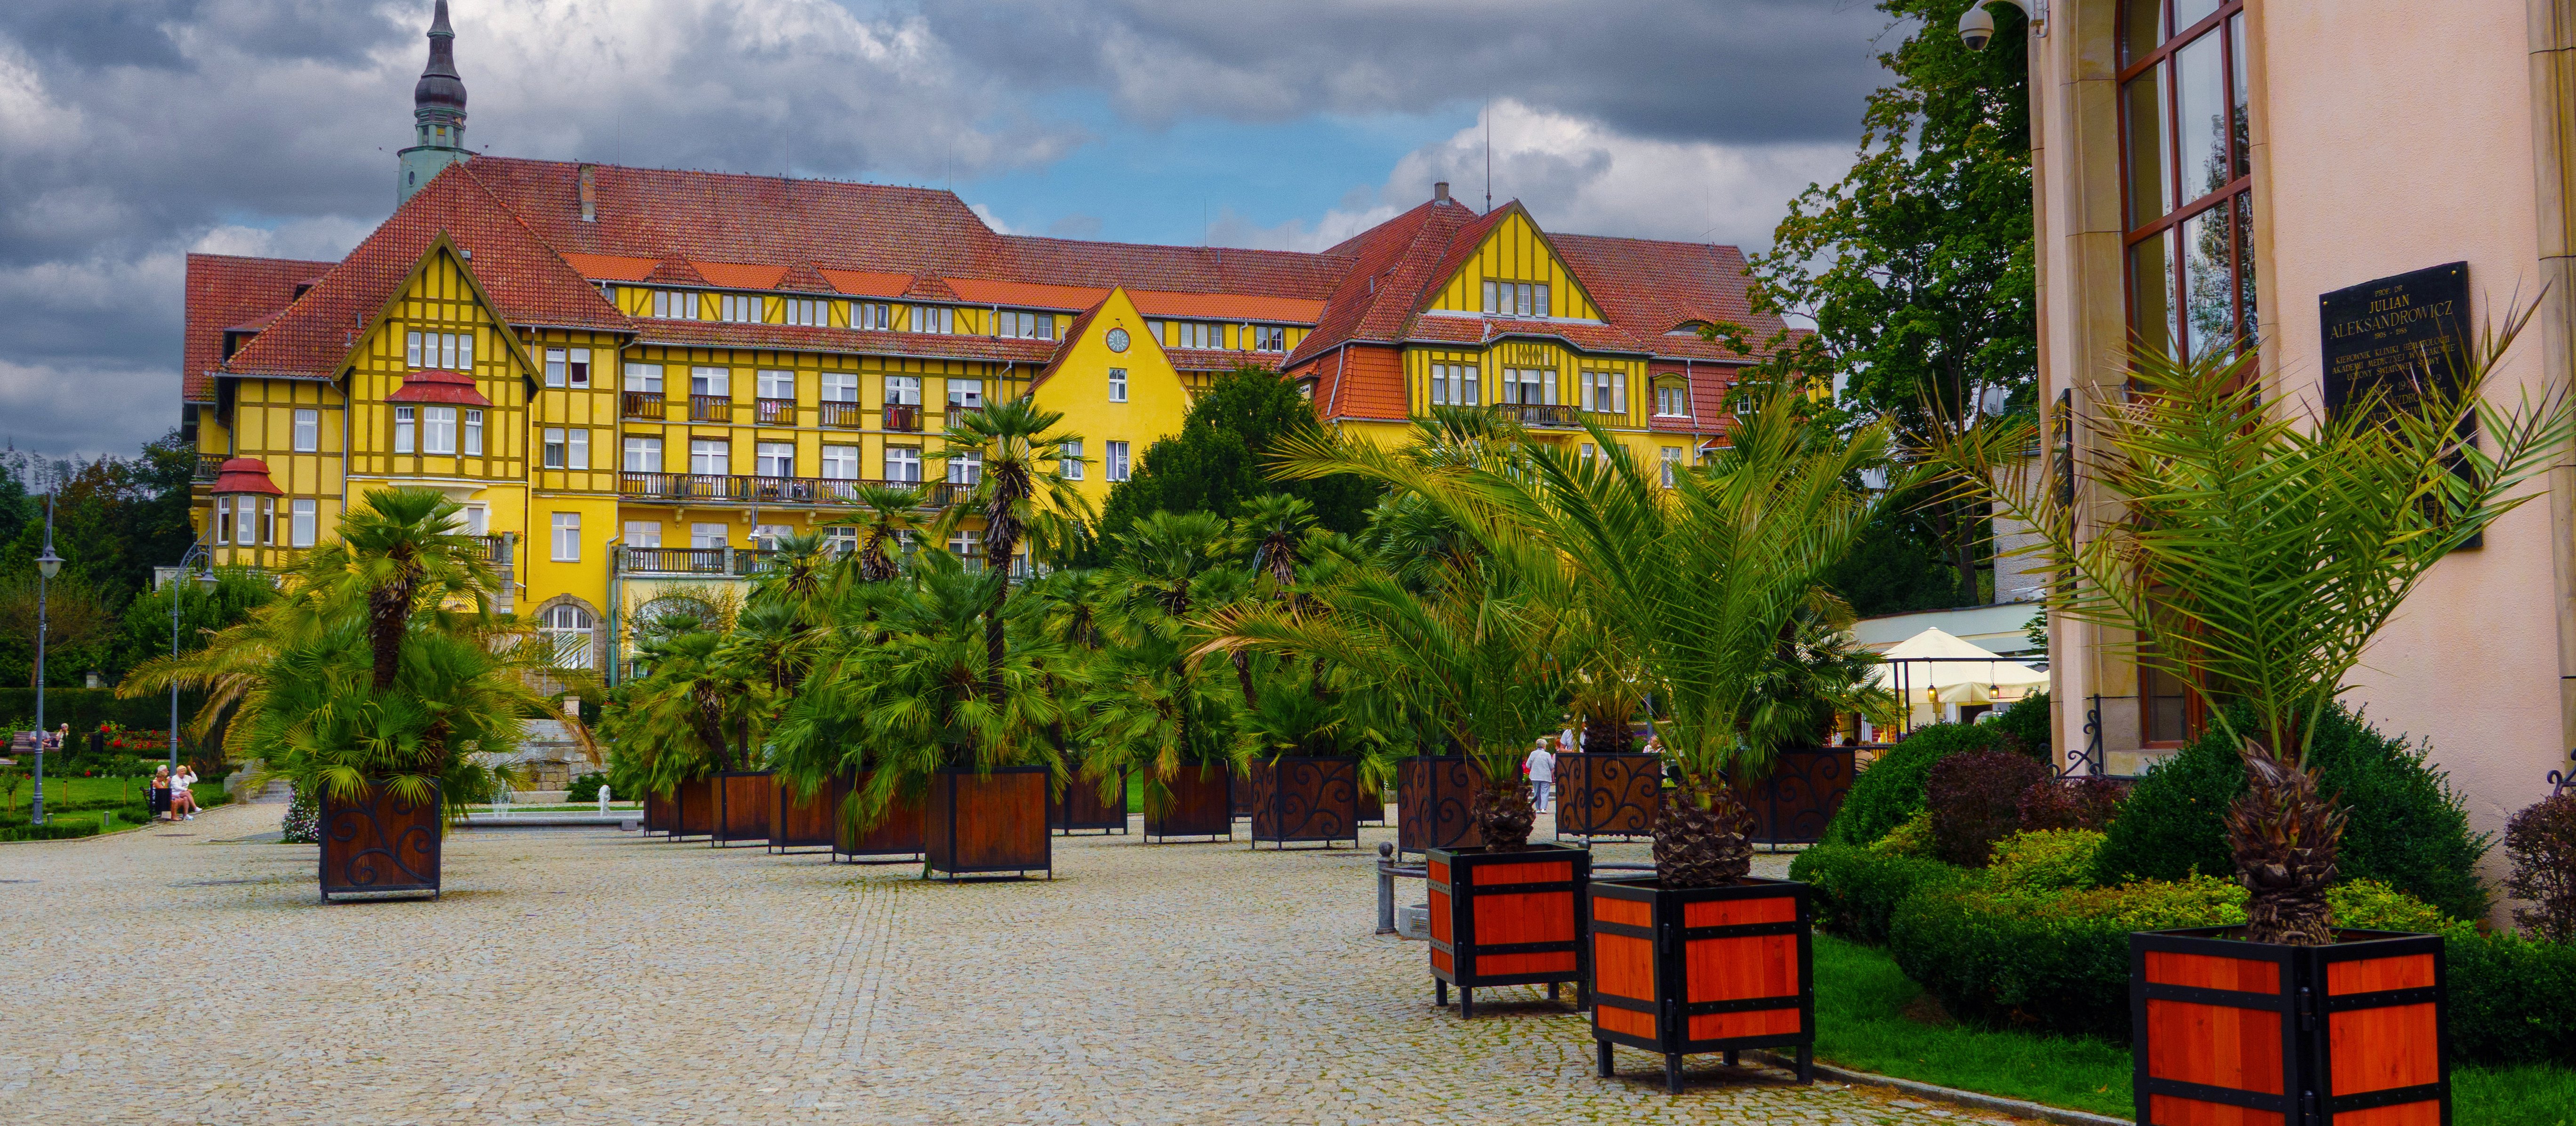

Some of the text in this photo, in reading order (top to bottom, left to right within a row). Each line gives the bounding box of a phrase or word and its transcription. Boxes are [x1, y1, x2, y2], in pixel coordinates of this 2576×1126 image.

[2375, 285, 2403, 297] PROF. DR
[2369, 294, 2410, 314] JULIAN
[2330, 300, 2453, 339] ALEKSANDROWICZ
[2336, 351, 2371, 364] KIEROWNIK
[2375, 346, 2399, 357] KLINIKI
[2368, 354, 2405, 368] MEDYCZNEJ
[2417, 356, 2440, 368] SAWY
